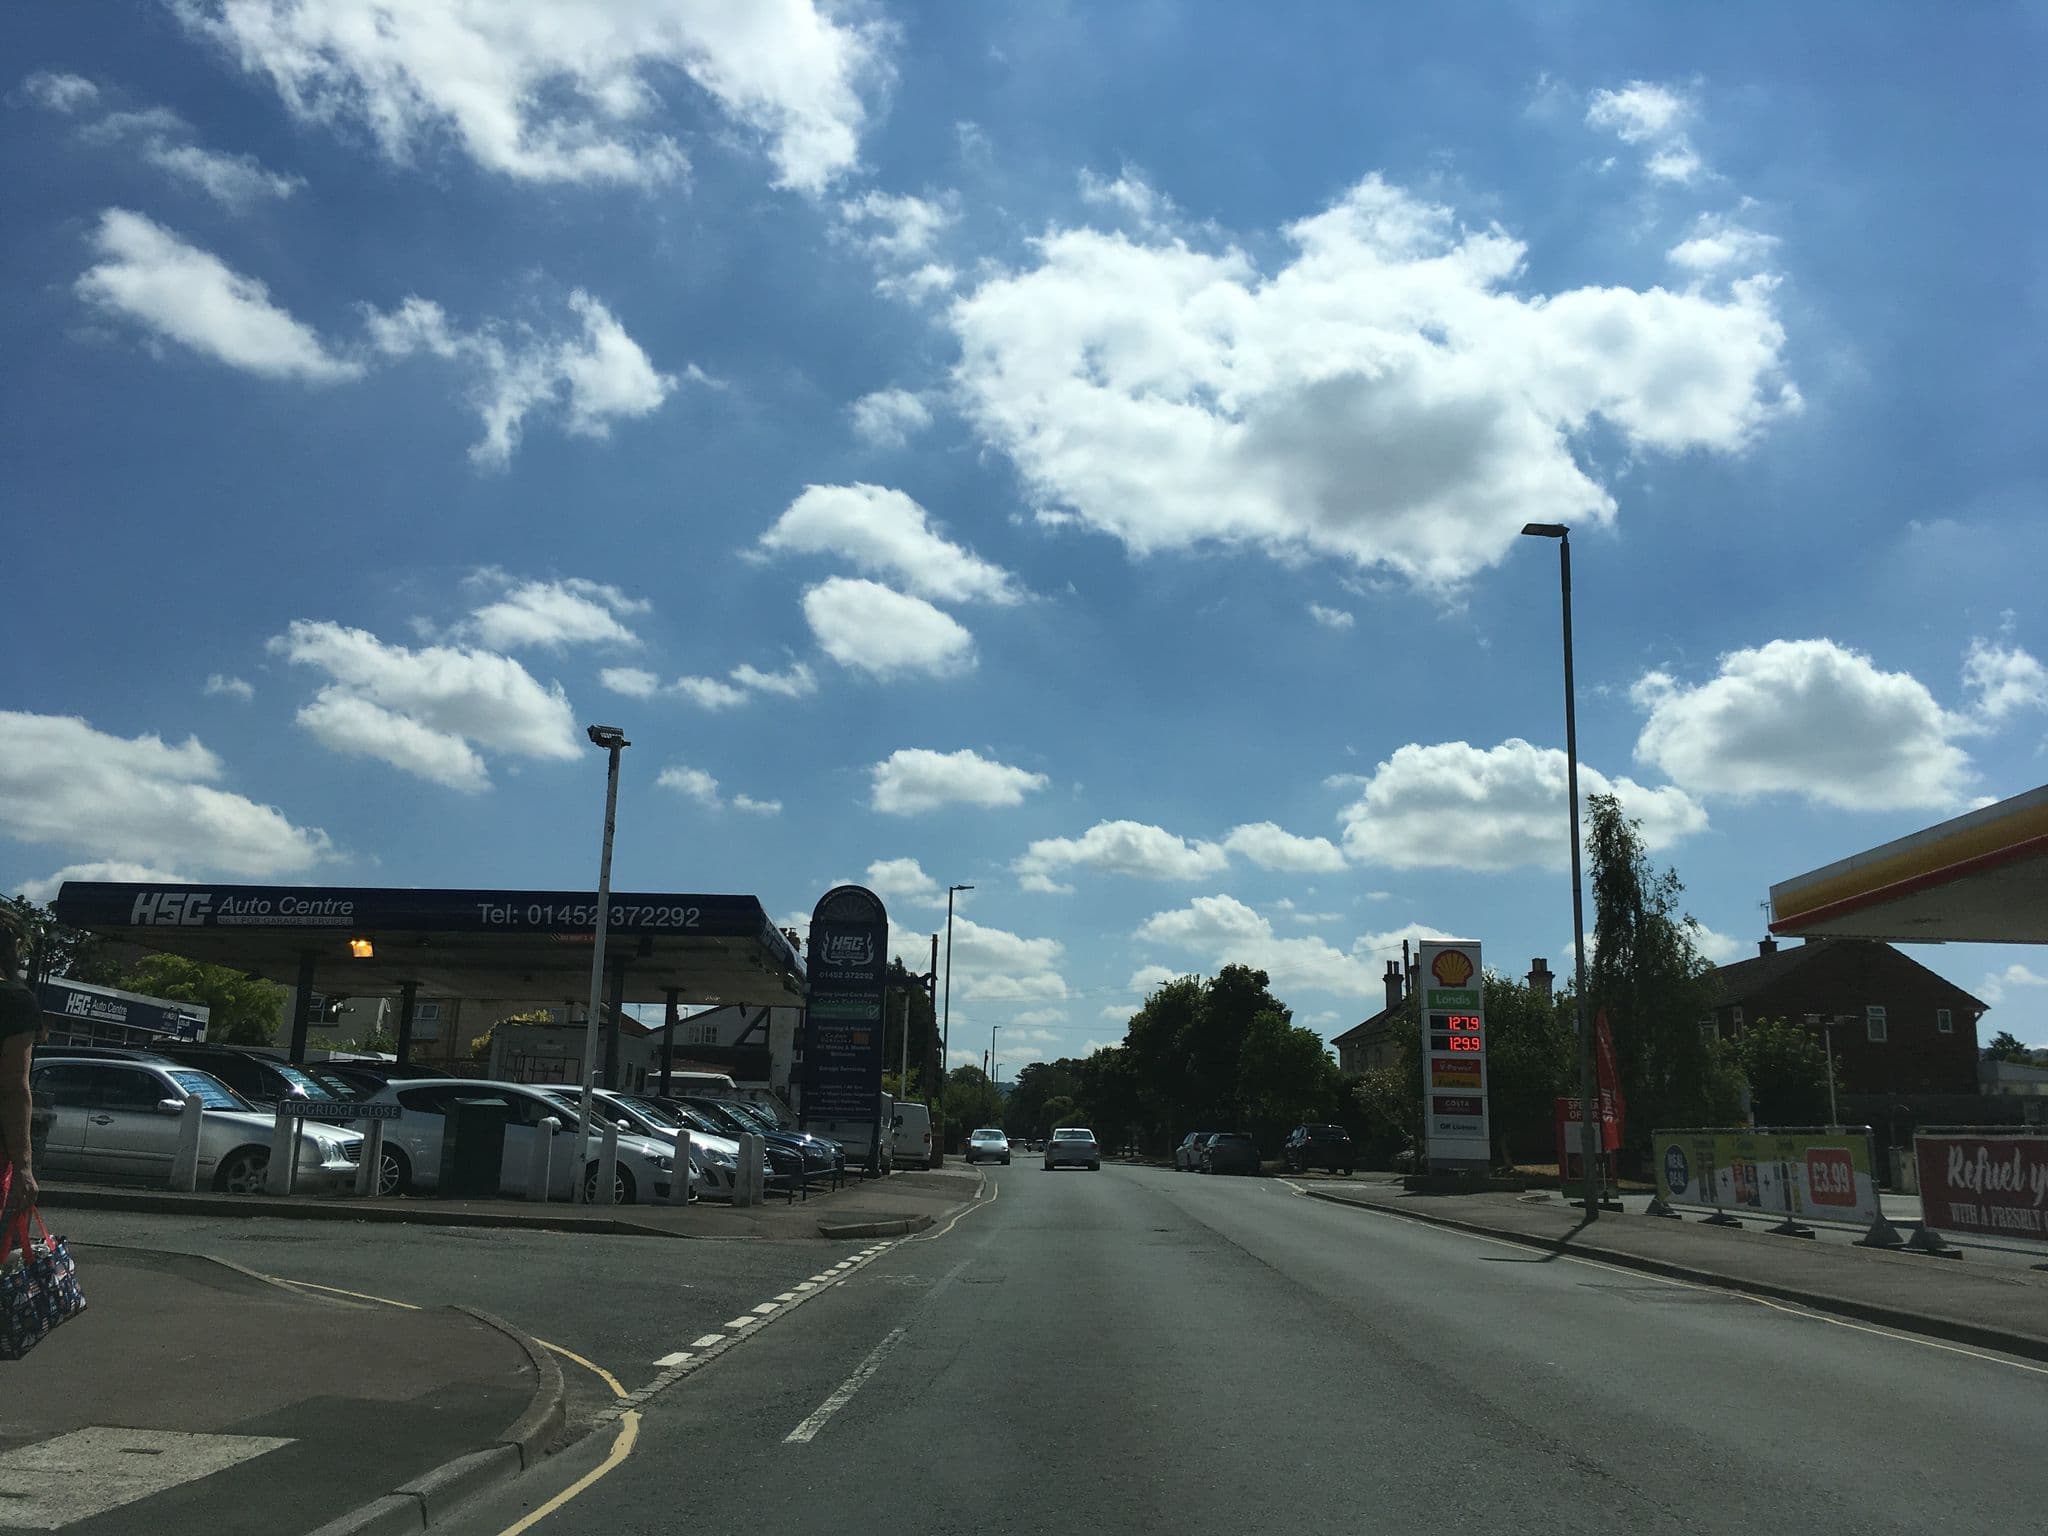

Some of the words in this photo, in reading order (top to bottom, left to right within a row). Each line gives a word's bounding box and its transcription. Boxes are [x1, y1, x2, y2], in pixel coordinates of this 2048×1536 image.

[217, 896, 272, 915] Auto
[279, 896, 354, 915] Centre
[477, 903, 519, 925] Tel:
[527, 904, 601, 926] 01452
[609, 905, 701, 928] 372292
[91, 999, 107, 1012] Auto
[107, 1002, 128, 1015] Centre
[1435, 993, 1471, 1006] Londis
[1447, 1016, 1480, 1031] 127.9
[1449, 1036, 1481, 1051] 129.9
[284, 1103, 353, 1117] MOGRIDGE
[359, 1105, 398, 1118] CLOSE
[1812, 1161, 1850, 1193] £3.99
[1947, 1144, 2026, 1195] Refuel
[1669, 1171, 1685, 1187] DEAL
[1949, 1202, 1978, 1225] WITH
[1981, 1204, 1990, 1226] A
[1991, 1205, 2041, 1231] FRESHLY
